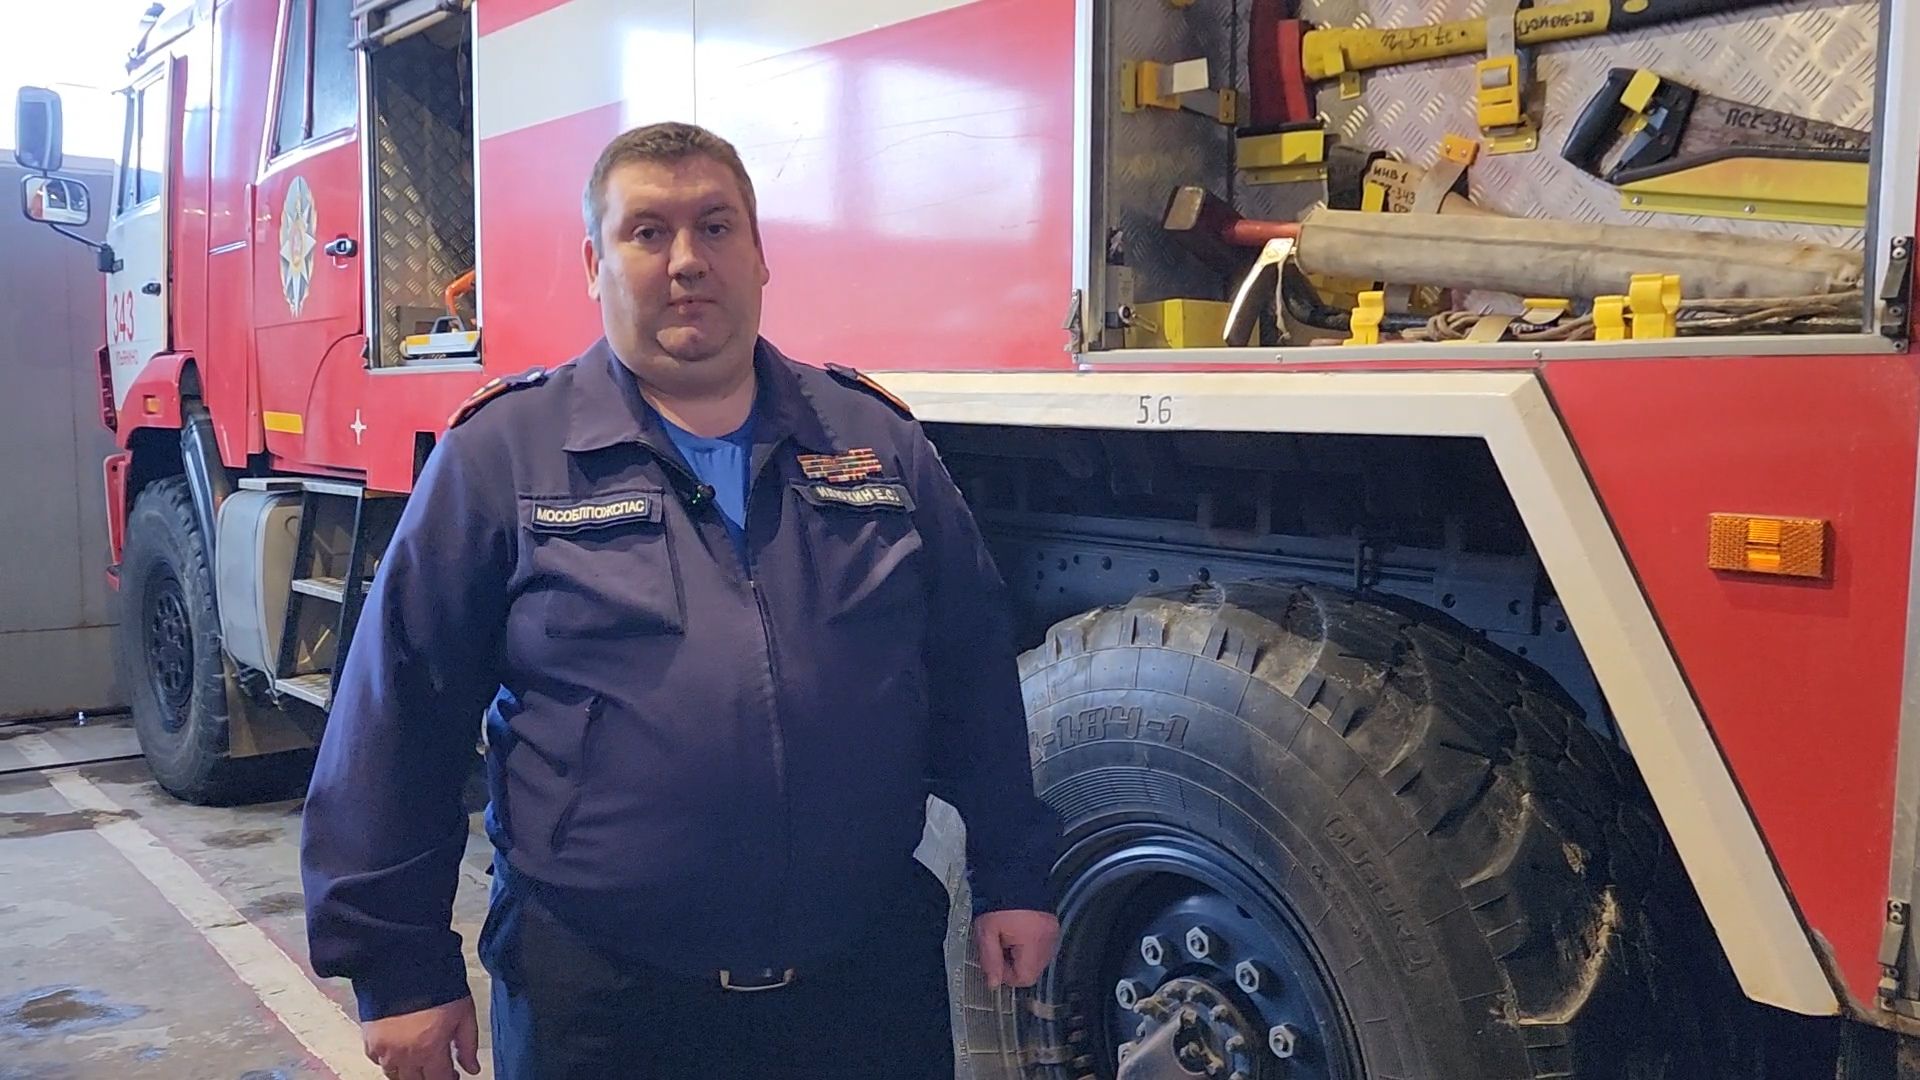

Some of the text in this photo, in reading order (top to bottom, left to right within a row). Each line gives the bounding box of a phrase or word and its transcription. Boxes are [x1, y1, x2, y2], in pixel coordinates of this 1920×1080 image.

[112, 290, 135, 344] 343
[1136, 395, 1172, 424] 5.6
[536, 500, 645, 522] МОСОБЛПОЖСПАС
